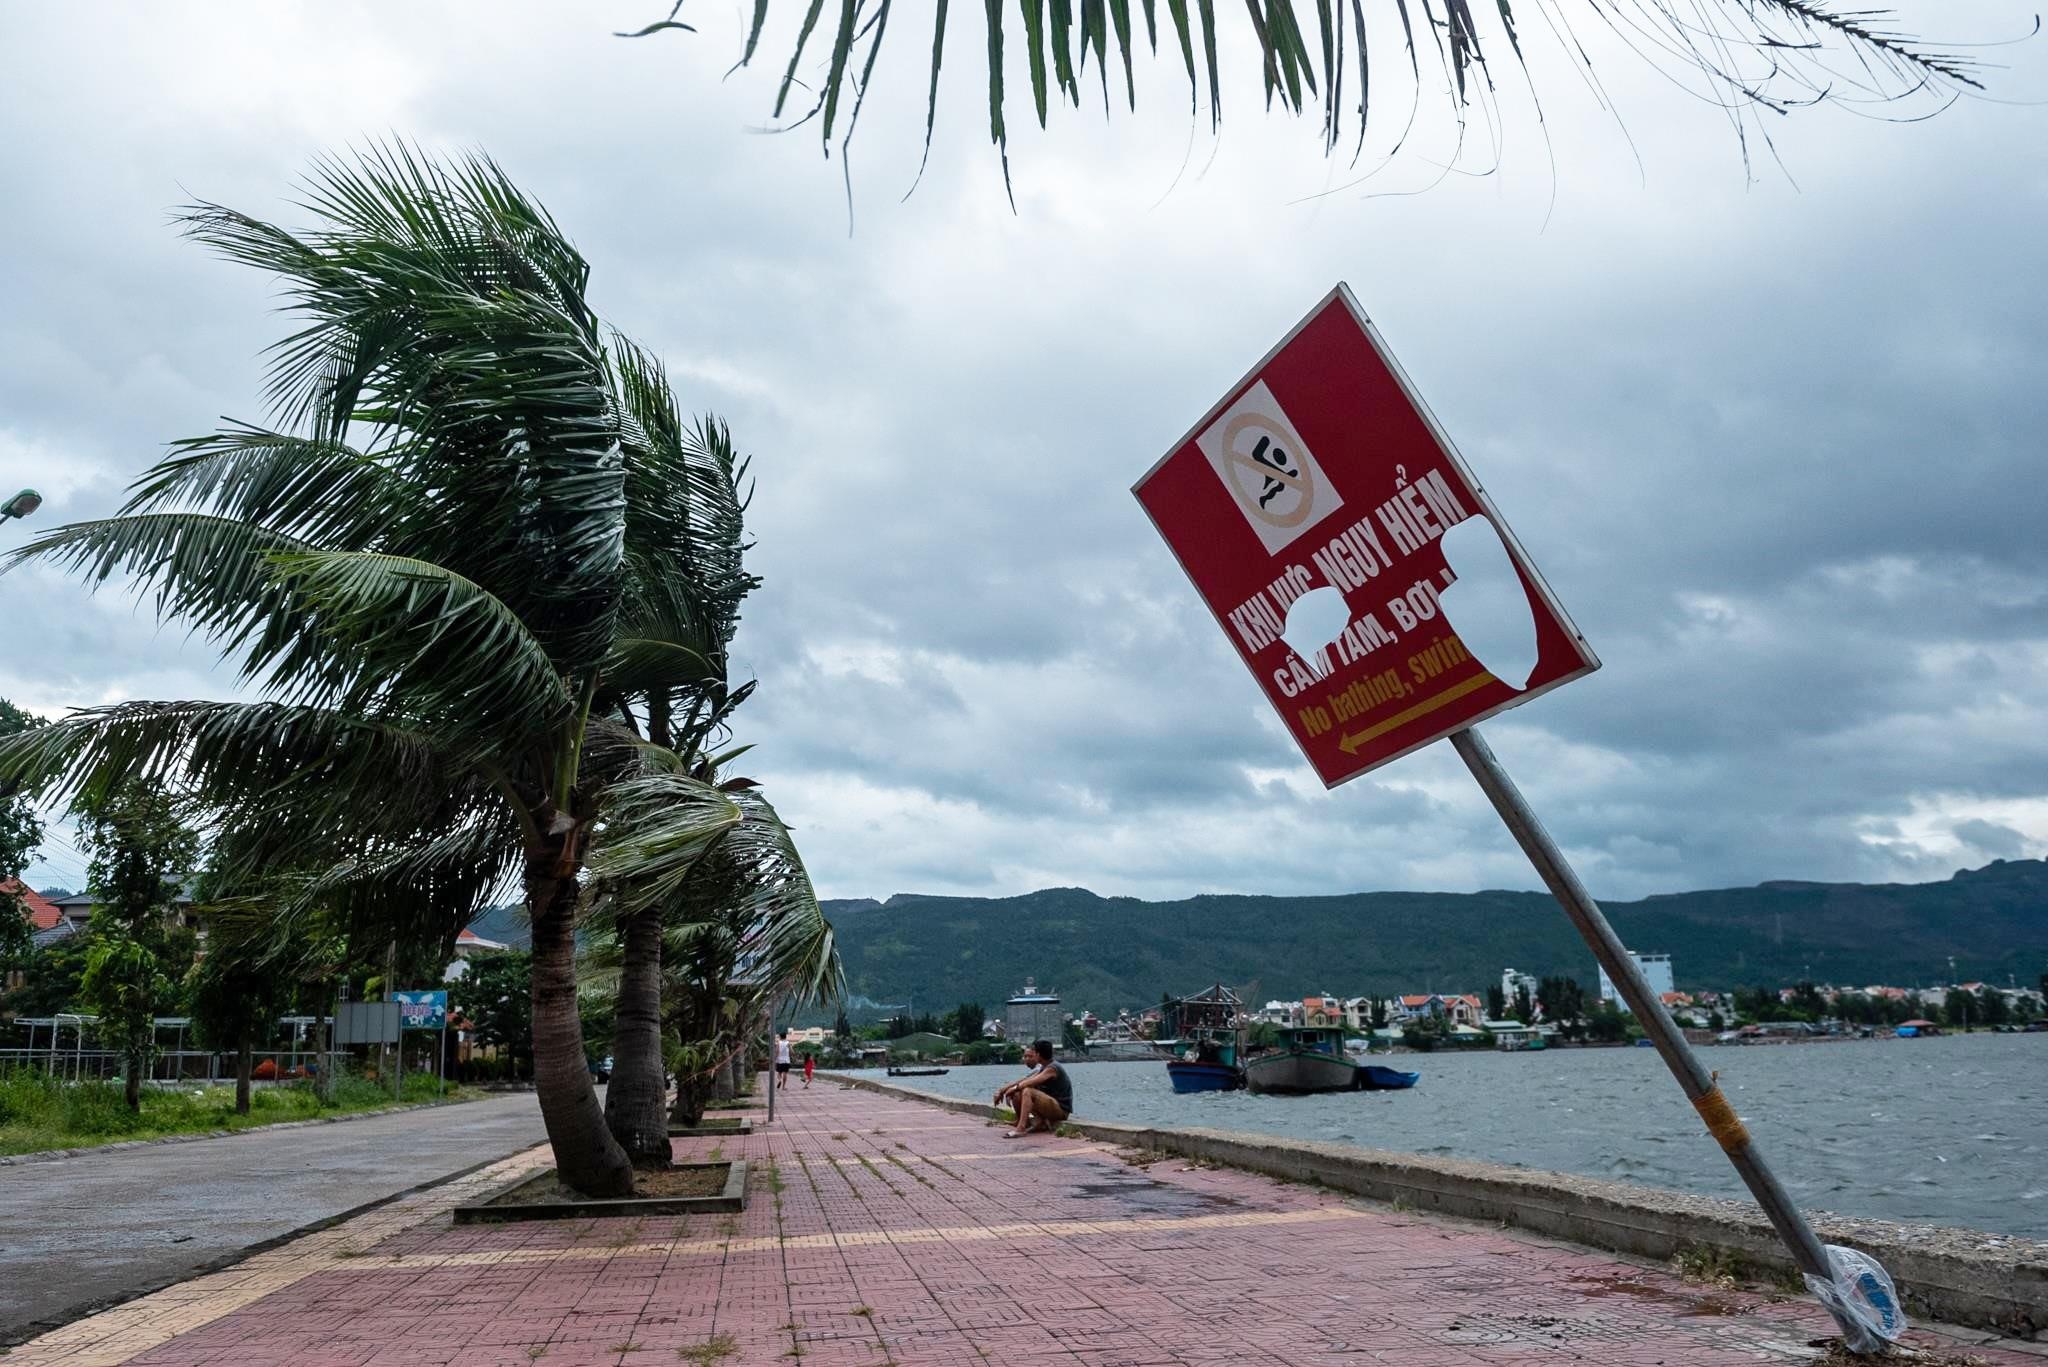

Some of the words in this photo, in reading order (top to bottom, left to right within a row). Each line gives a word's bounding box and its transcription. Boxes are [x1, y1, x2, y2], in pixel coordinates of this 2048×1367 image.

[1228, 592, 1285, 653] KHU
[1311, 516, 1393, 597] NGUY
[1375, 464, 1469, 556] HIỂM
[1299, 705, 1332, 738] No
[1327, 667, 1415, 724] bathing,
